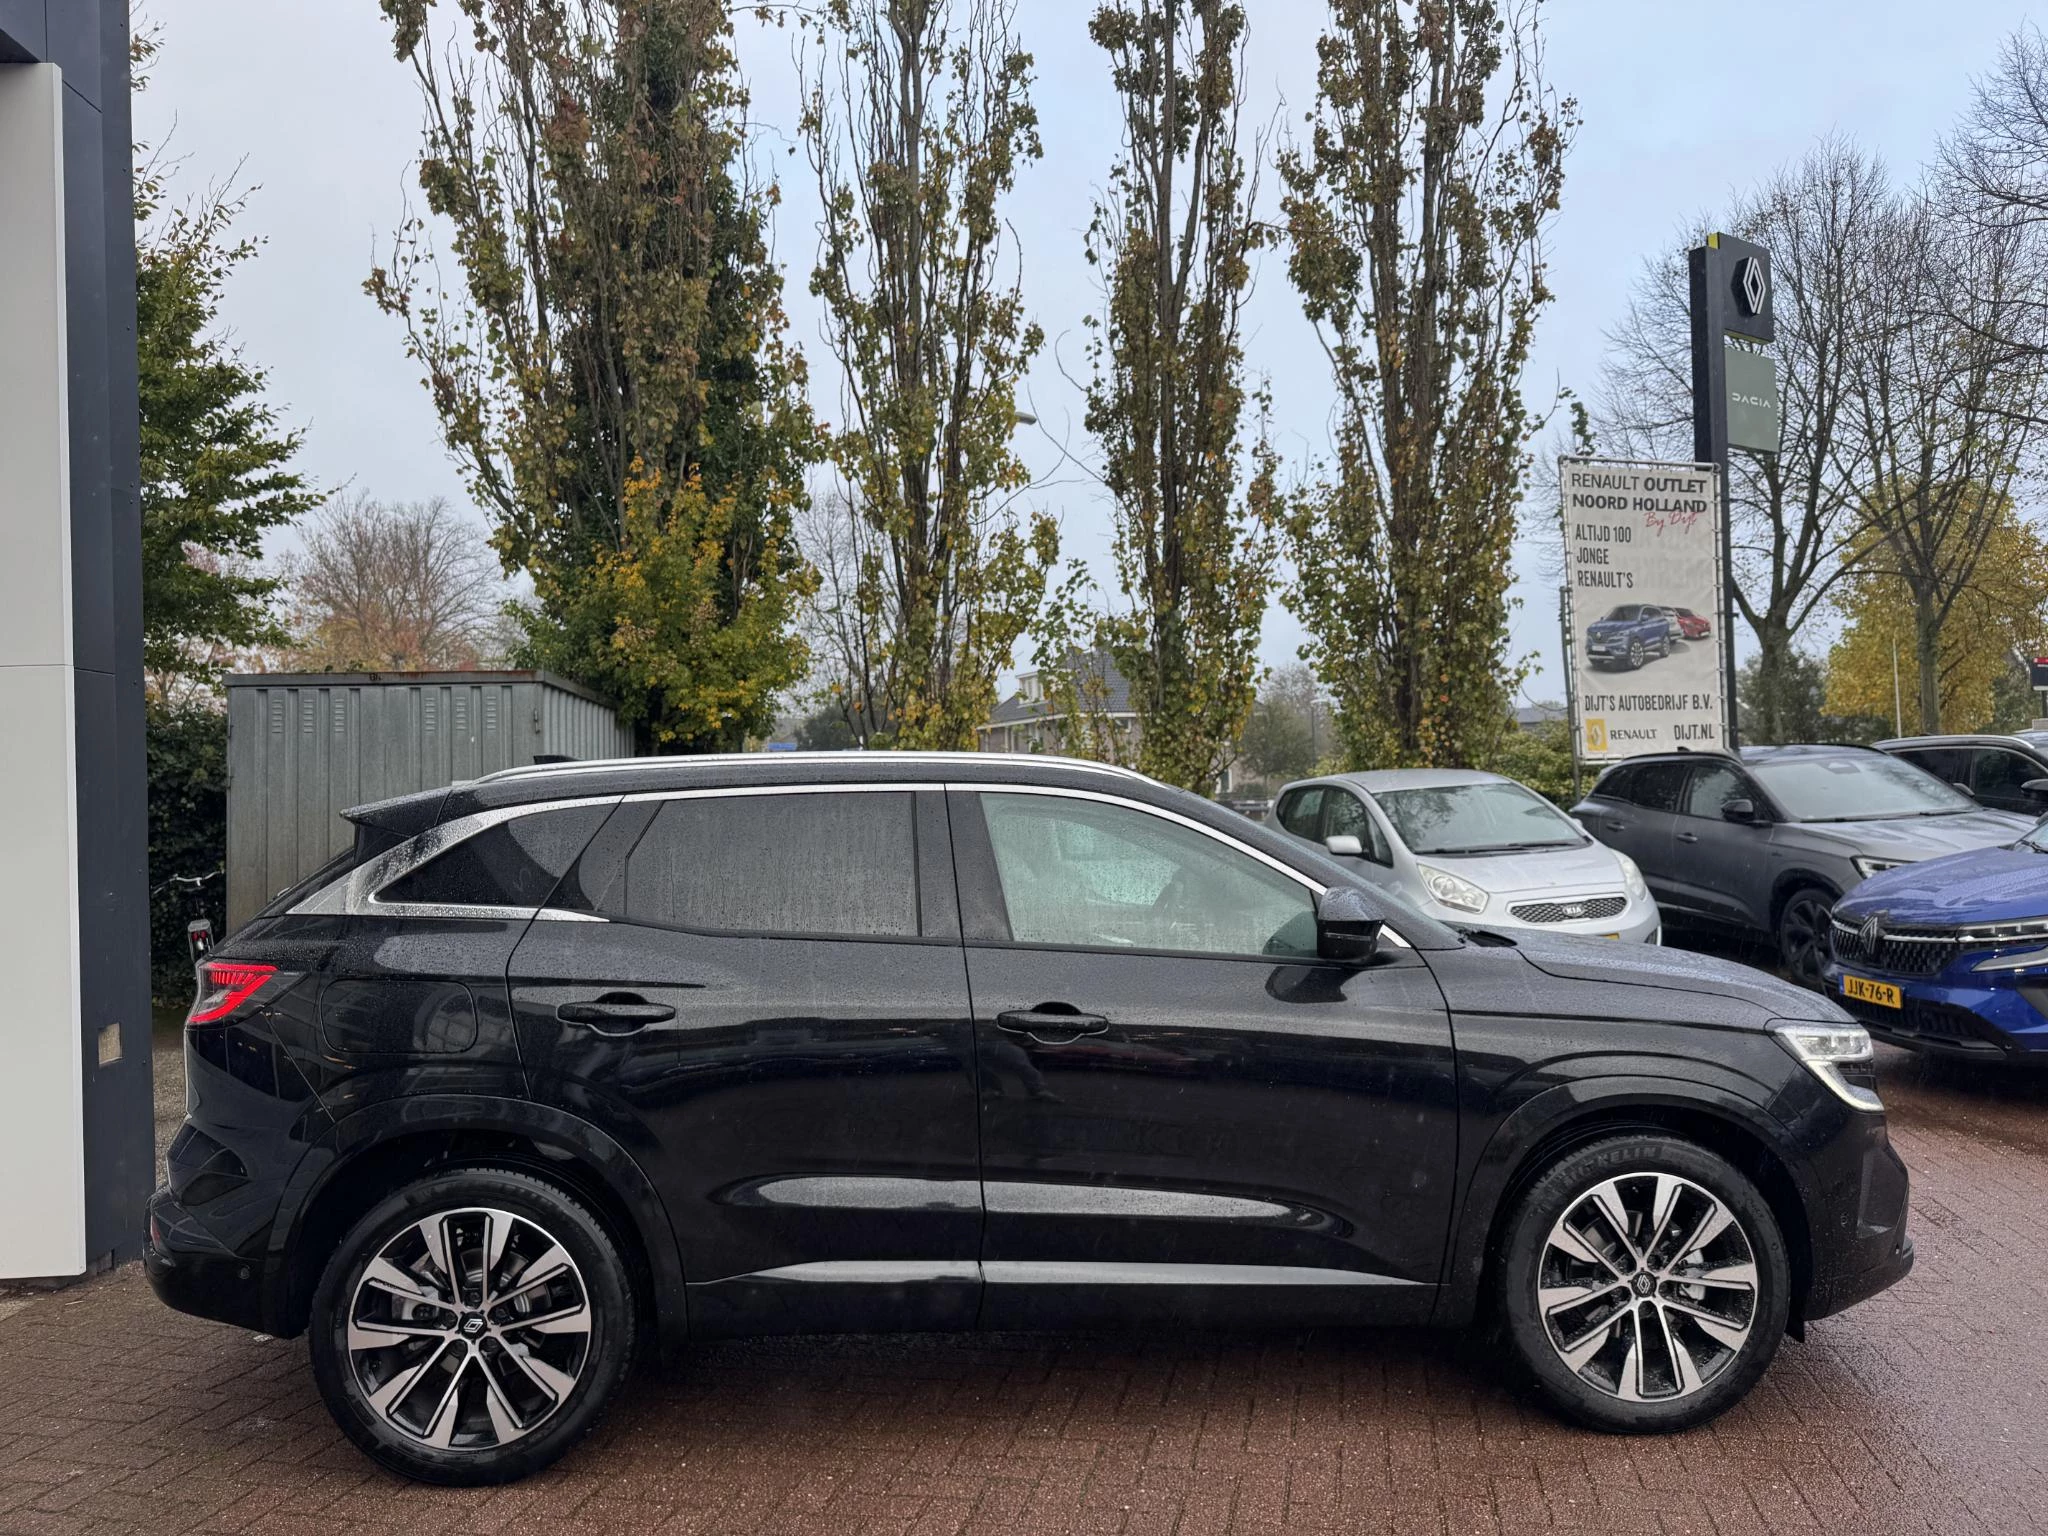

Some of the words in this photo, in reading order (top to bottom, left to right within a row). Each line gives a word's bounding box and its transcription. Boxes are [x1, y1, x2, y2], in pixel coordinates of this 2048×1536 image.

[1731, 392, 1771, 409] DACIA
[1571, 473, 1640, 491] RENAULT
[1643, 477, 1707, 493] OUTLET
[1573, 494, 1627, 509] NOORD
[1633, 498, 1707, 513] HOLLAND
[1575, 523, 1611, 543] ALTIJD
[1613, 526, 1632, 543] 100
[1644, 511, 1665, 536] By
[1576, 547, 1610, 565] JONGE
[1577, 570, 1634, 589] RENAULT'S
[1584, 694, 1616, 712] DIJT'S
[1618, 694, 1689, 711] AUTOBEDRIJF
[1692, 694, 1713, 710] B.V.
[1610, 729, 1657, 741] RENAULT
[1673, 723, 1715, 741] DIJT.NL
[1566, 906, 1582, 914] KIA
[1847, 978, 1895, 1005] JJK-76-R
